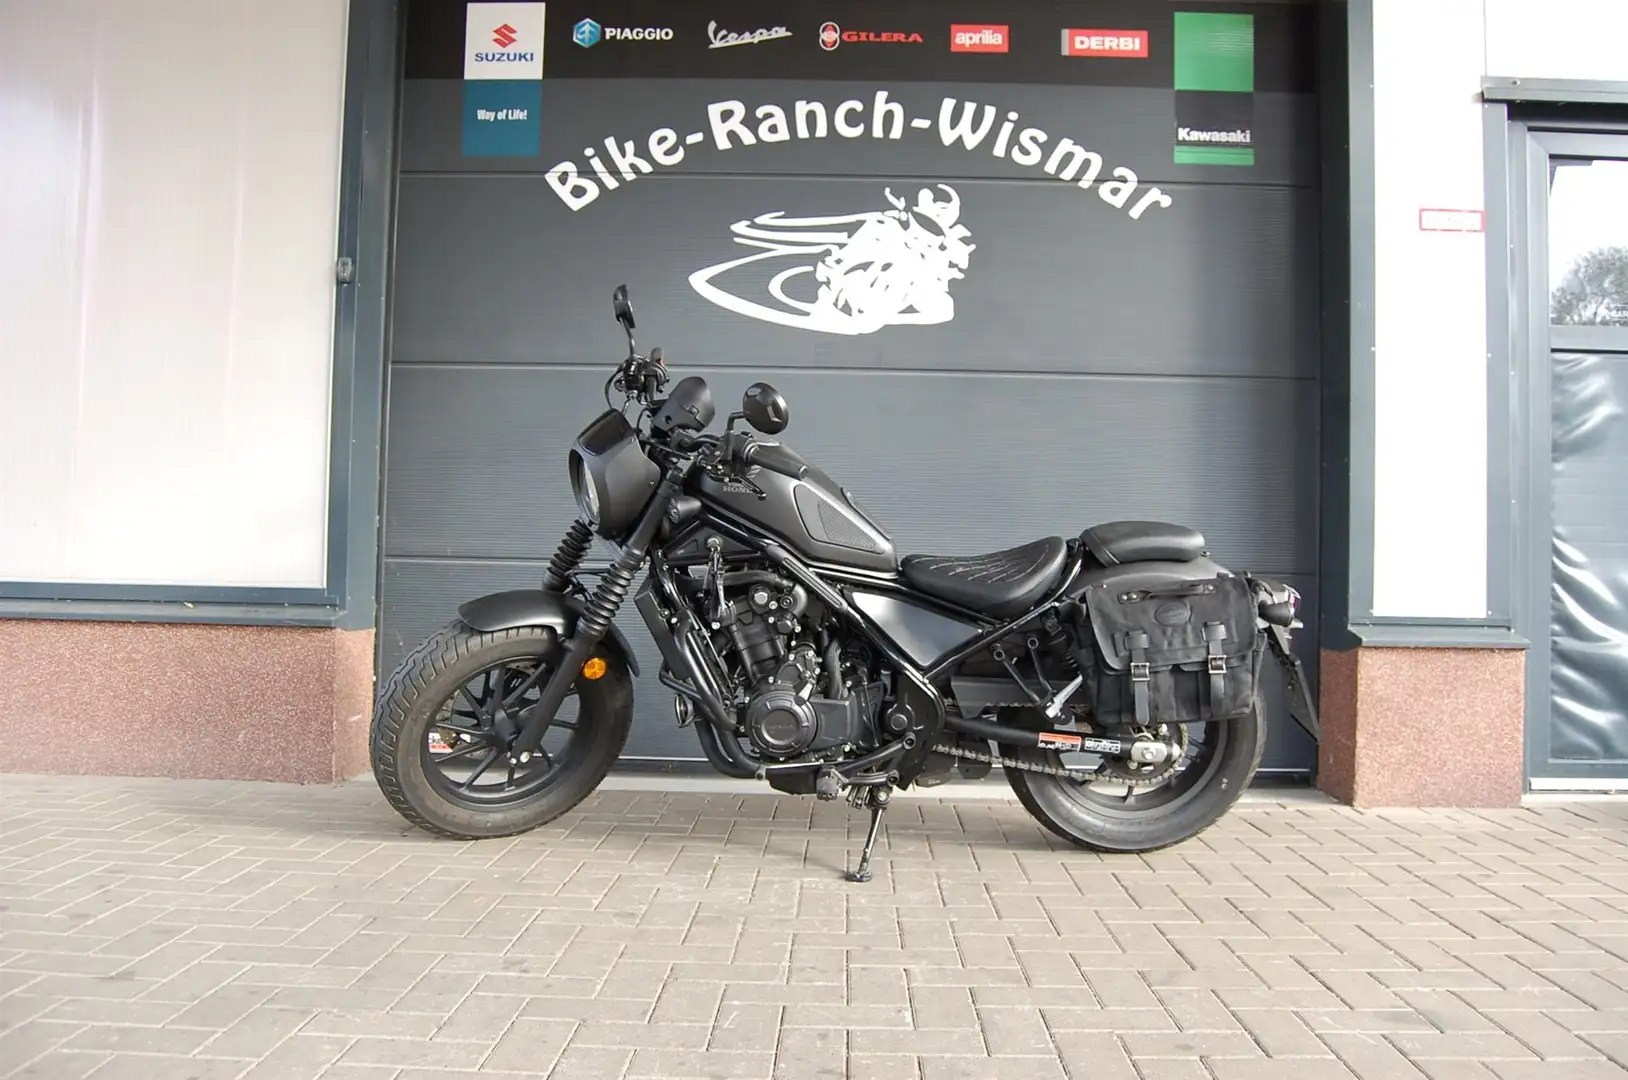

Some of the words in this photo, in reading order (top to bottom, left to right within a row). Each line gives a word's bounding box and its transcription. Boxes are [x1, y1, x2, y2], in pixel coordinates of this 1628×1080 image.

[605, 28, 674, 41] PIAGGIO
[707, 20, 792, 49] Vespa
[842, 31, 923, 43] GILERA
[955, 29, 1003, 47] aprilia
[1074, 36, 1141, 51] DERBI
[475, 53, 534, 62] SUZUKI
[477, 109, 495, 122] Way
[497, 109, 507, 120] of
[508, 109, 528, 120] Life!
[1177, 127, 1251, 143] Kawasaki
[545, 90, 1173, 220] Bike-Ranch-Wismar
